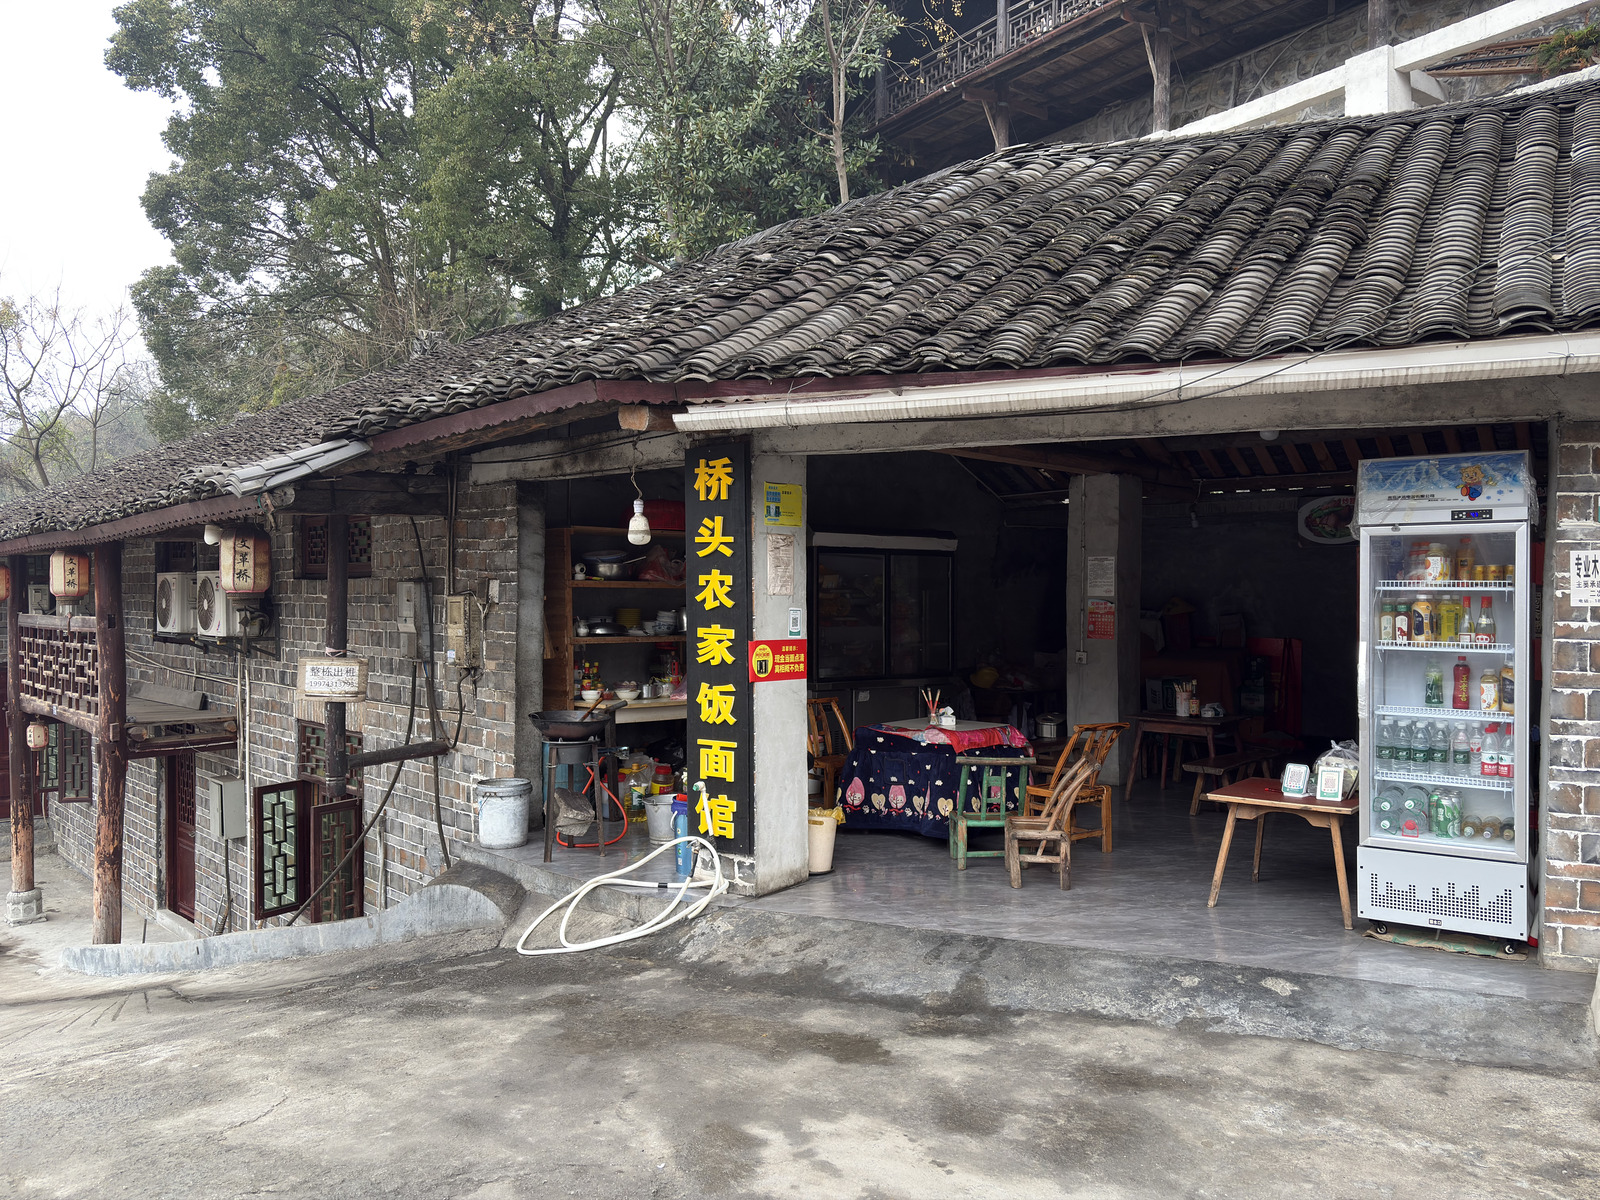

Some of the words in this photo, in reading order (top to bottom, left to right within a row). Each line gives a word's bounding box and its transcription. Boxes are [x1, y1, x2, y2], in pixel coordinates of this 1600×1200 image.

[693, 456, 738, 841] 桥头农家饭面馆
[309, 666, 356, 677] 整栋出租
[1458, 674, 1469, 702] 王老吉
